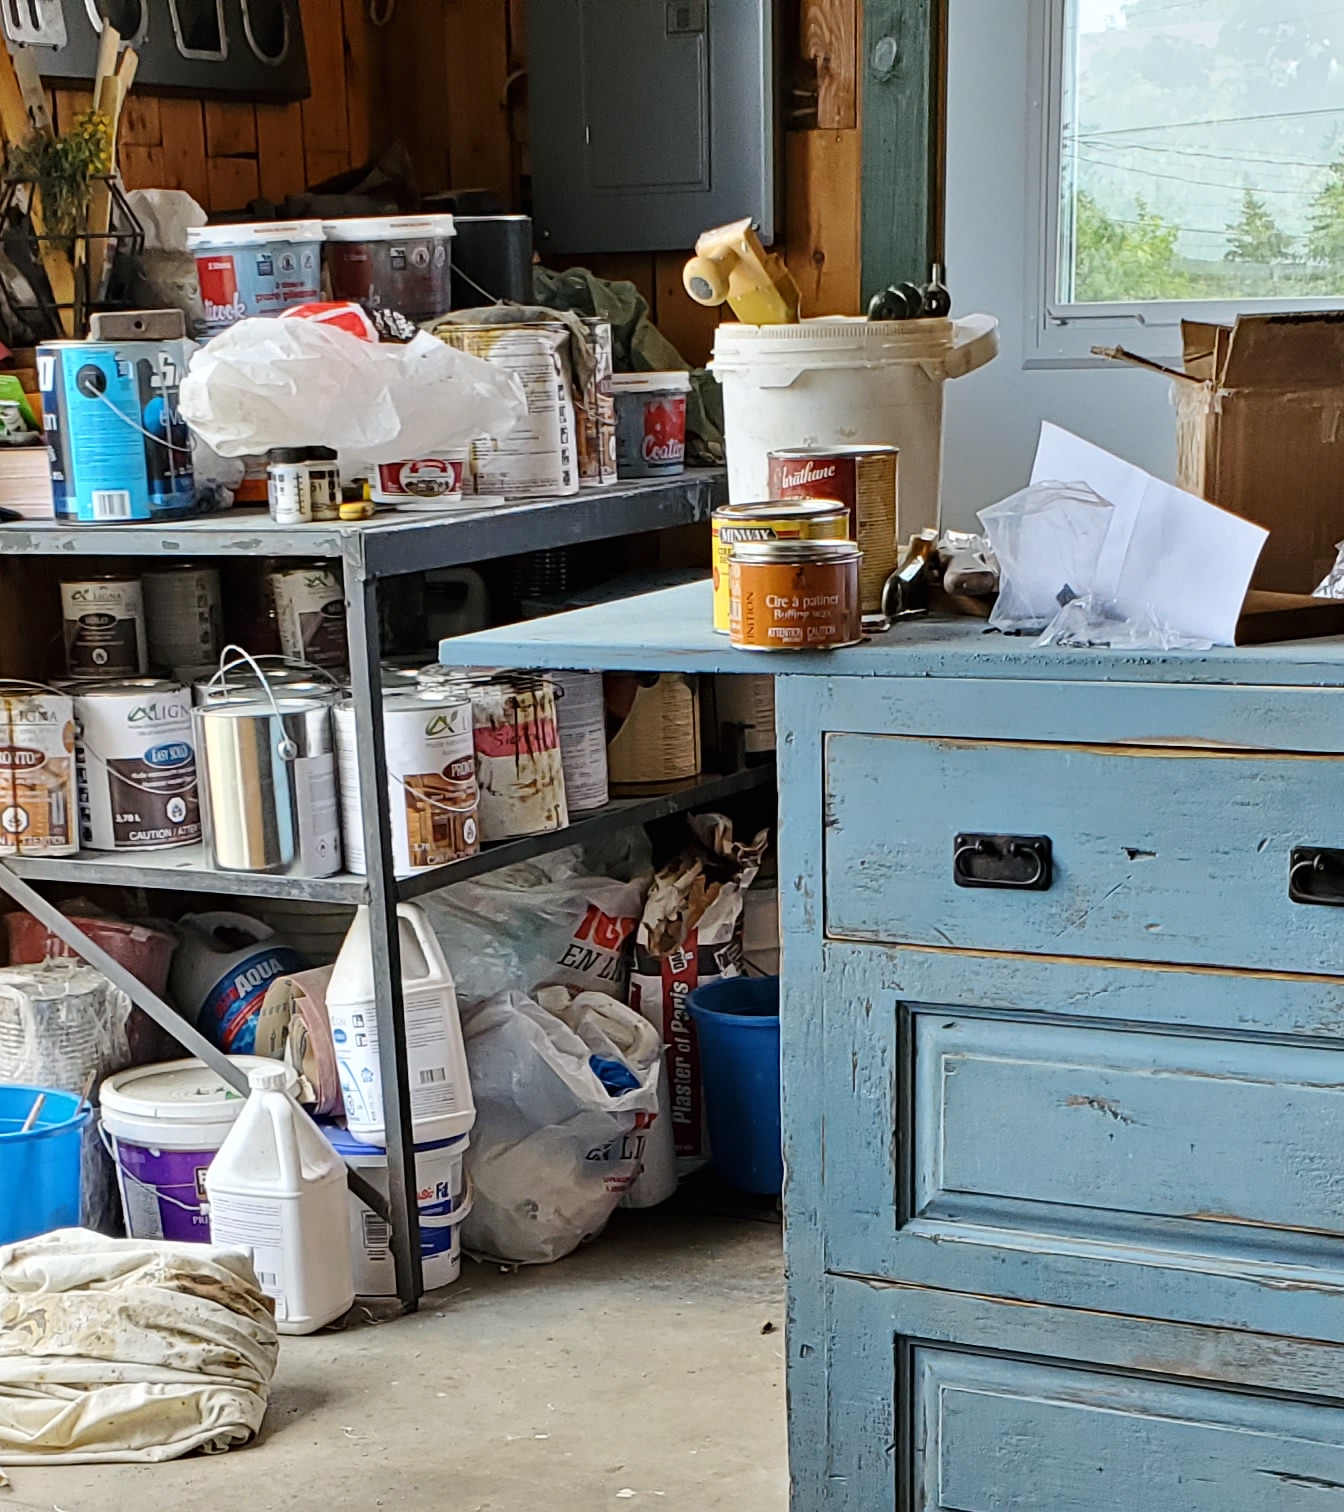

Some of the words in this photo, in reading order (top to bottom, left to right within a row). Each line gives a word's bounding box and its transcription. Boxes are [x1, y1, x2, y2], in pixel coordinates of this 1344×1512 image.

[765, 594, 789, 608] Cire
[792, 595, 799, 608] à
[154, 703, 193, 721] LIGN
[128, 827, 172, 841] CAUTION
[556, 943, 604, 972] EN
[669, 981, 692, 1035] Paris
[672, 1057, 692, 1124] Plaster
